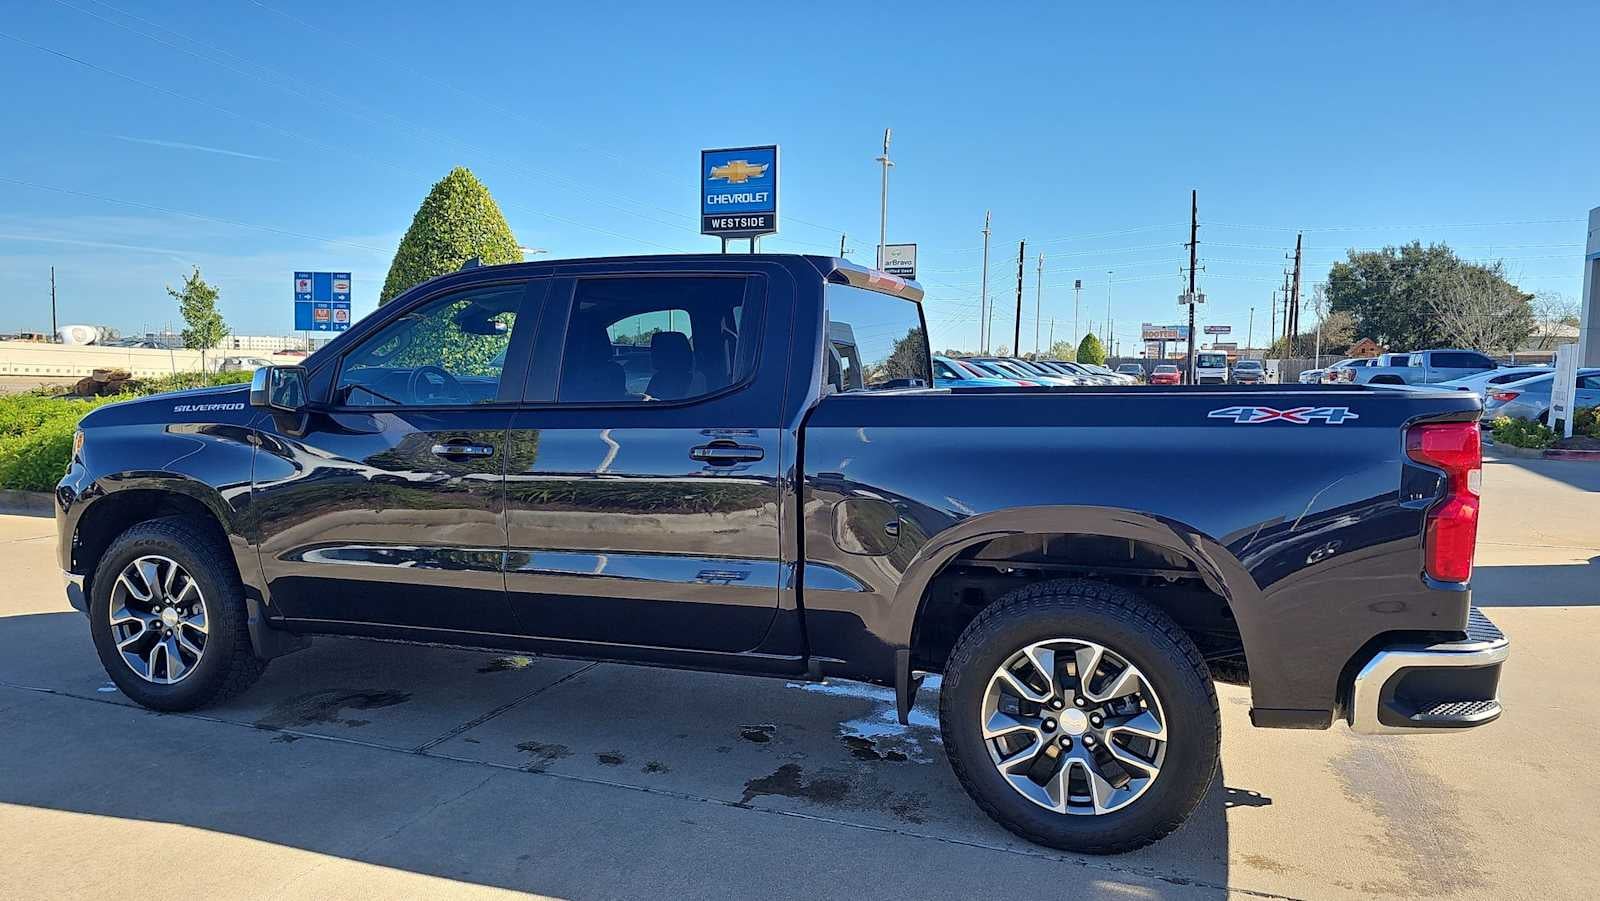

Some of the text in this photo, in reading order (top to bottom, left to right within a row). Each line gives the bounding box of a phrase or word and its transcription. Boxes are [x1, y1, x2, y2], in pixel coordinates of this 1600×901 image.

[707, 192, 769, 204] CHEVROLET
[712, 217, 764, 228] WESTSIDE
[174, 403, 245, 412] SILVERADO
